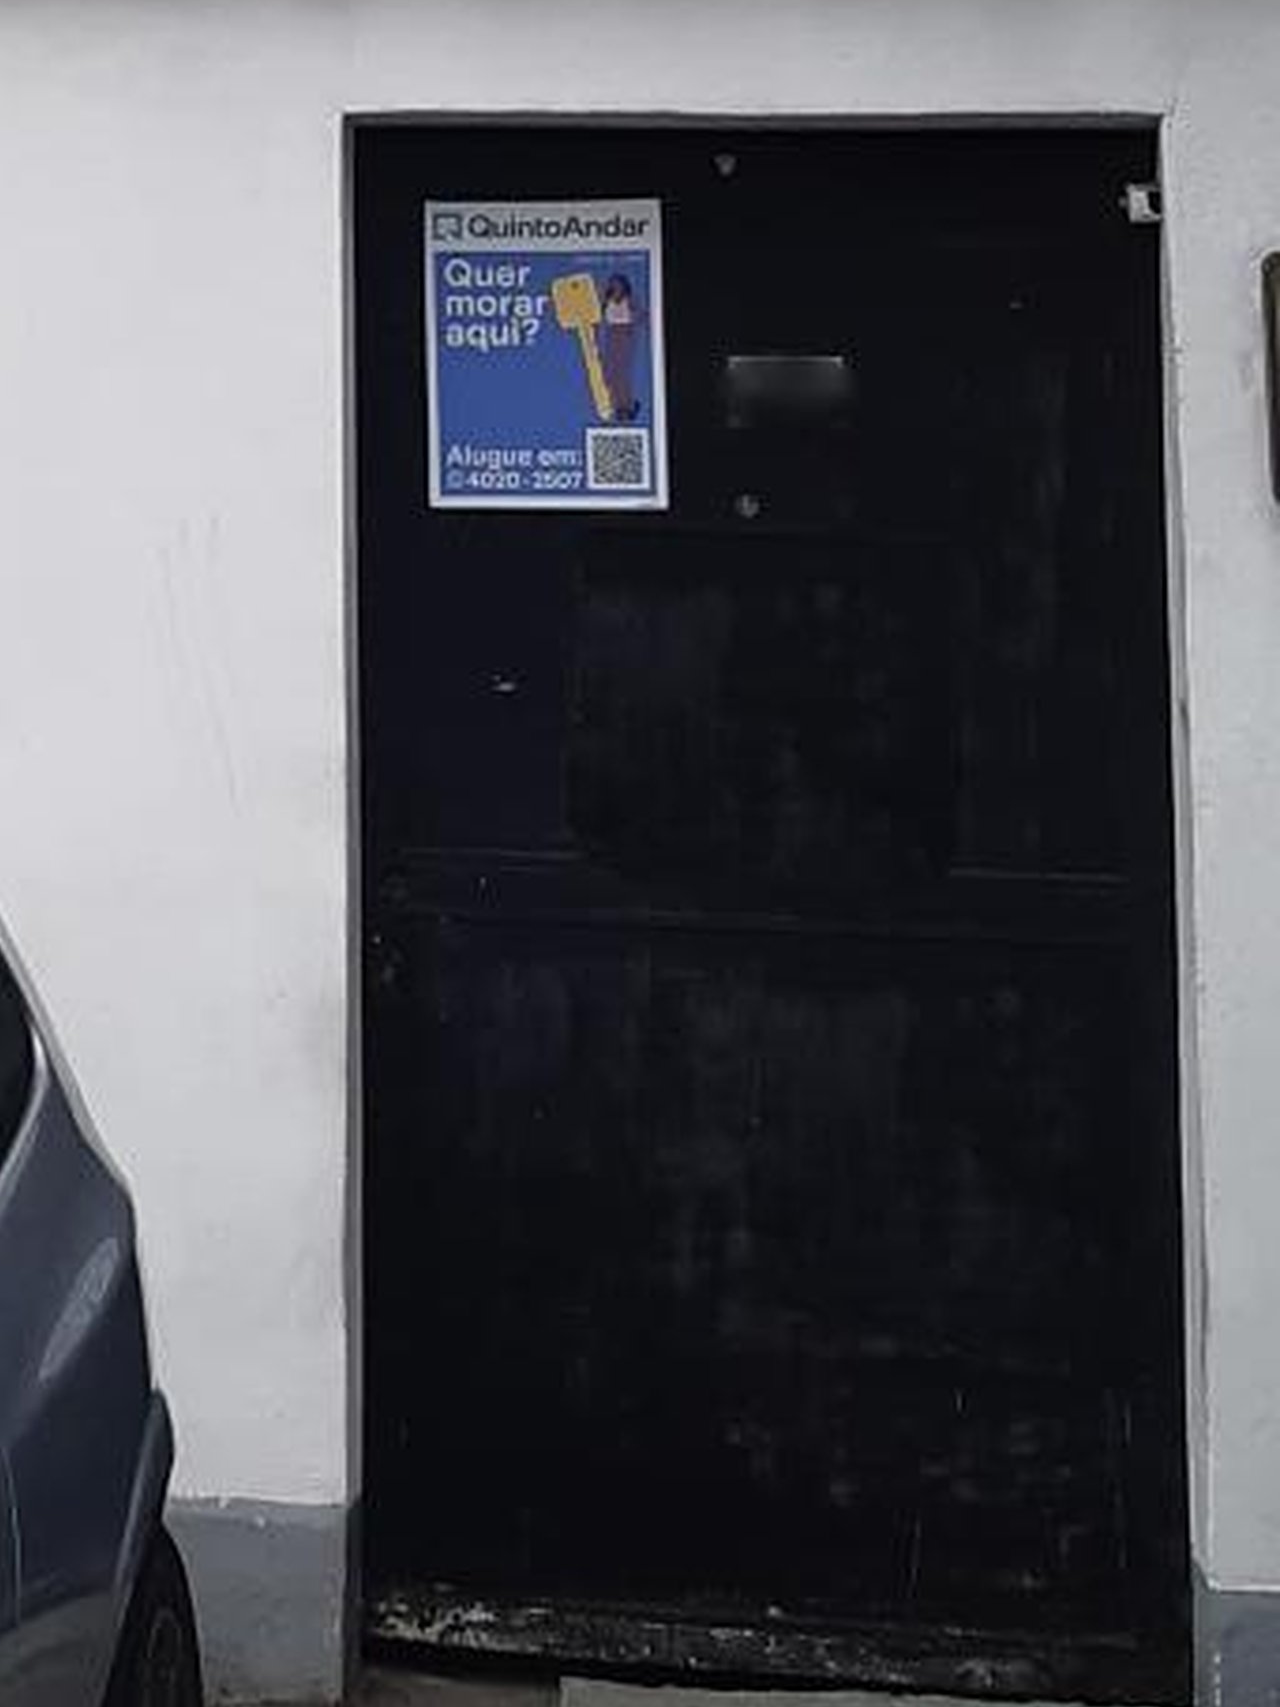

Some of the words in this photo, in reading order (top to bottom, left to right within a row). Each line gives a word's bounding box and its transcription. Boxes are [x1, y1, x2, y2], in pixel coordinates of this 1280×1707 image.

[467, 213, 649, 241] QuintoAndar
[444, 259, 531, 288] Quer
[446, 292, 548, 317] morar
[446, 319, 539, 351] aqui?
[446, 445, 532, 470] Alugue
[536, 450, 583, 466] em:
